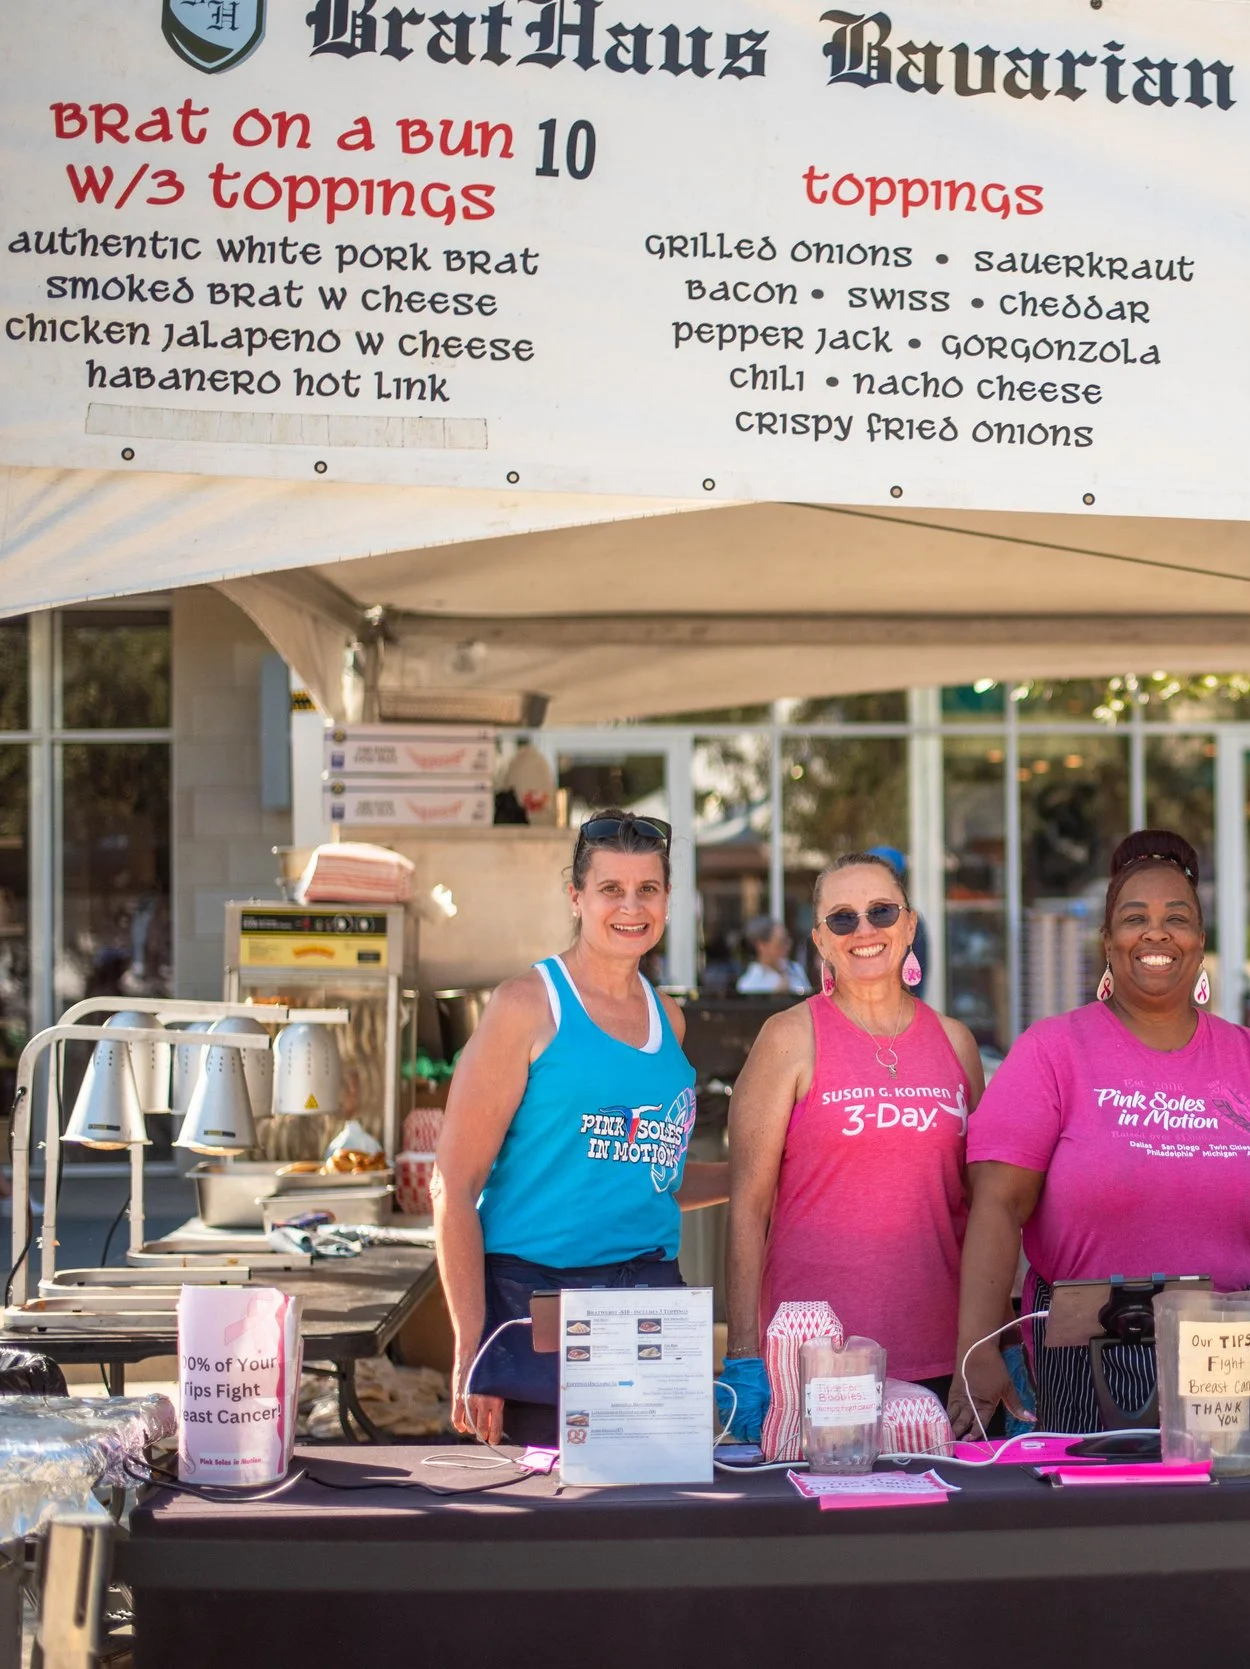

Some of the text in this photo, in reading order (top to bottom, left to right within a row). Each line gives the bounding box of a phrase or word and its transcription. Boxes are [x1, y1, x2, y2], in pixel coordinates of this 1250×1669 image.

[305, 0, 771, 81] BratHaus
[819, 9, 1237, 111] Bavarian
[535, 117, 597, 181] 10
[1093, 1088, 1206, 1112] Pink Soles
[579, 1113, 685, 1146] PINK SOLES
[1117, 1109, 1219, 1131] in Motion
[587, 1137, 676, 1168] IN MOTION
[1192, 1334, 1212, 1347] Our
[215, 1358, 232, 1372] of
[237, 1357, 276, 1372] Your
[1207, 1356, 1245, 1375] Fight
[216, 1383, 261, 1402] Fight
[1188, 1379, 1228, 1394] Breast
[217, 1404, 281, 1424] Cancer!
[1192, 1401, 1241, 1415] THANK
